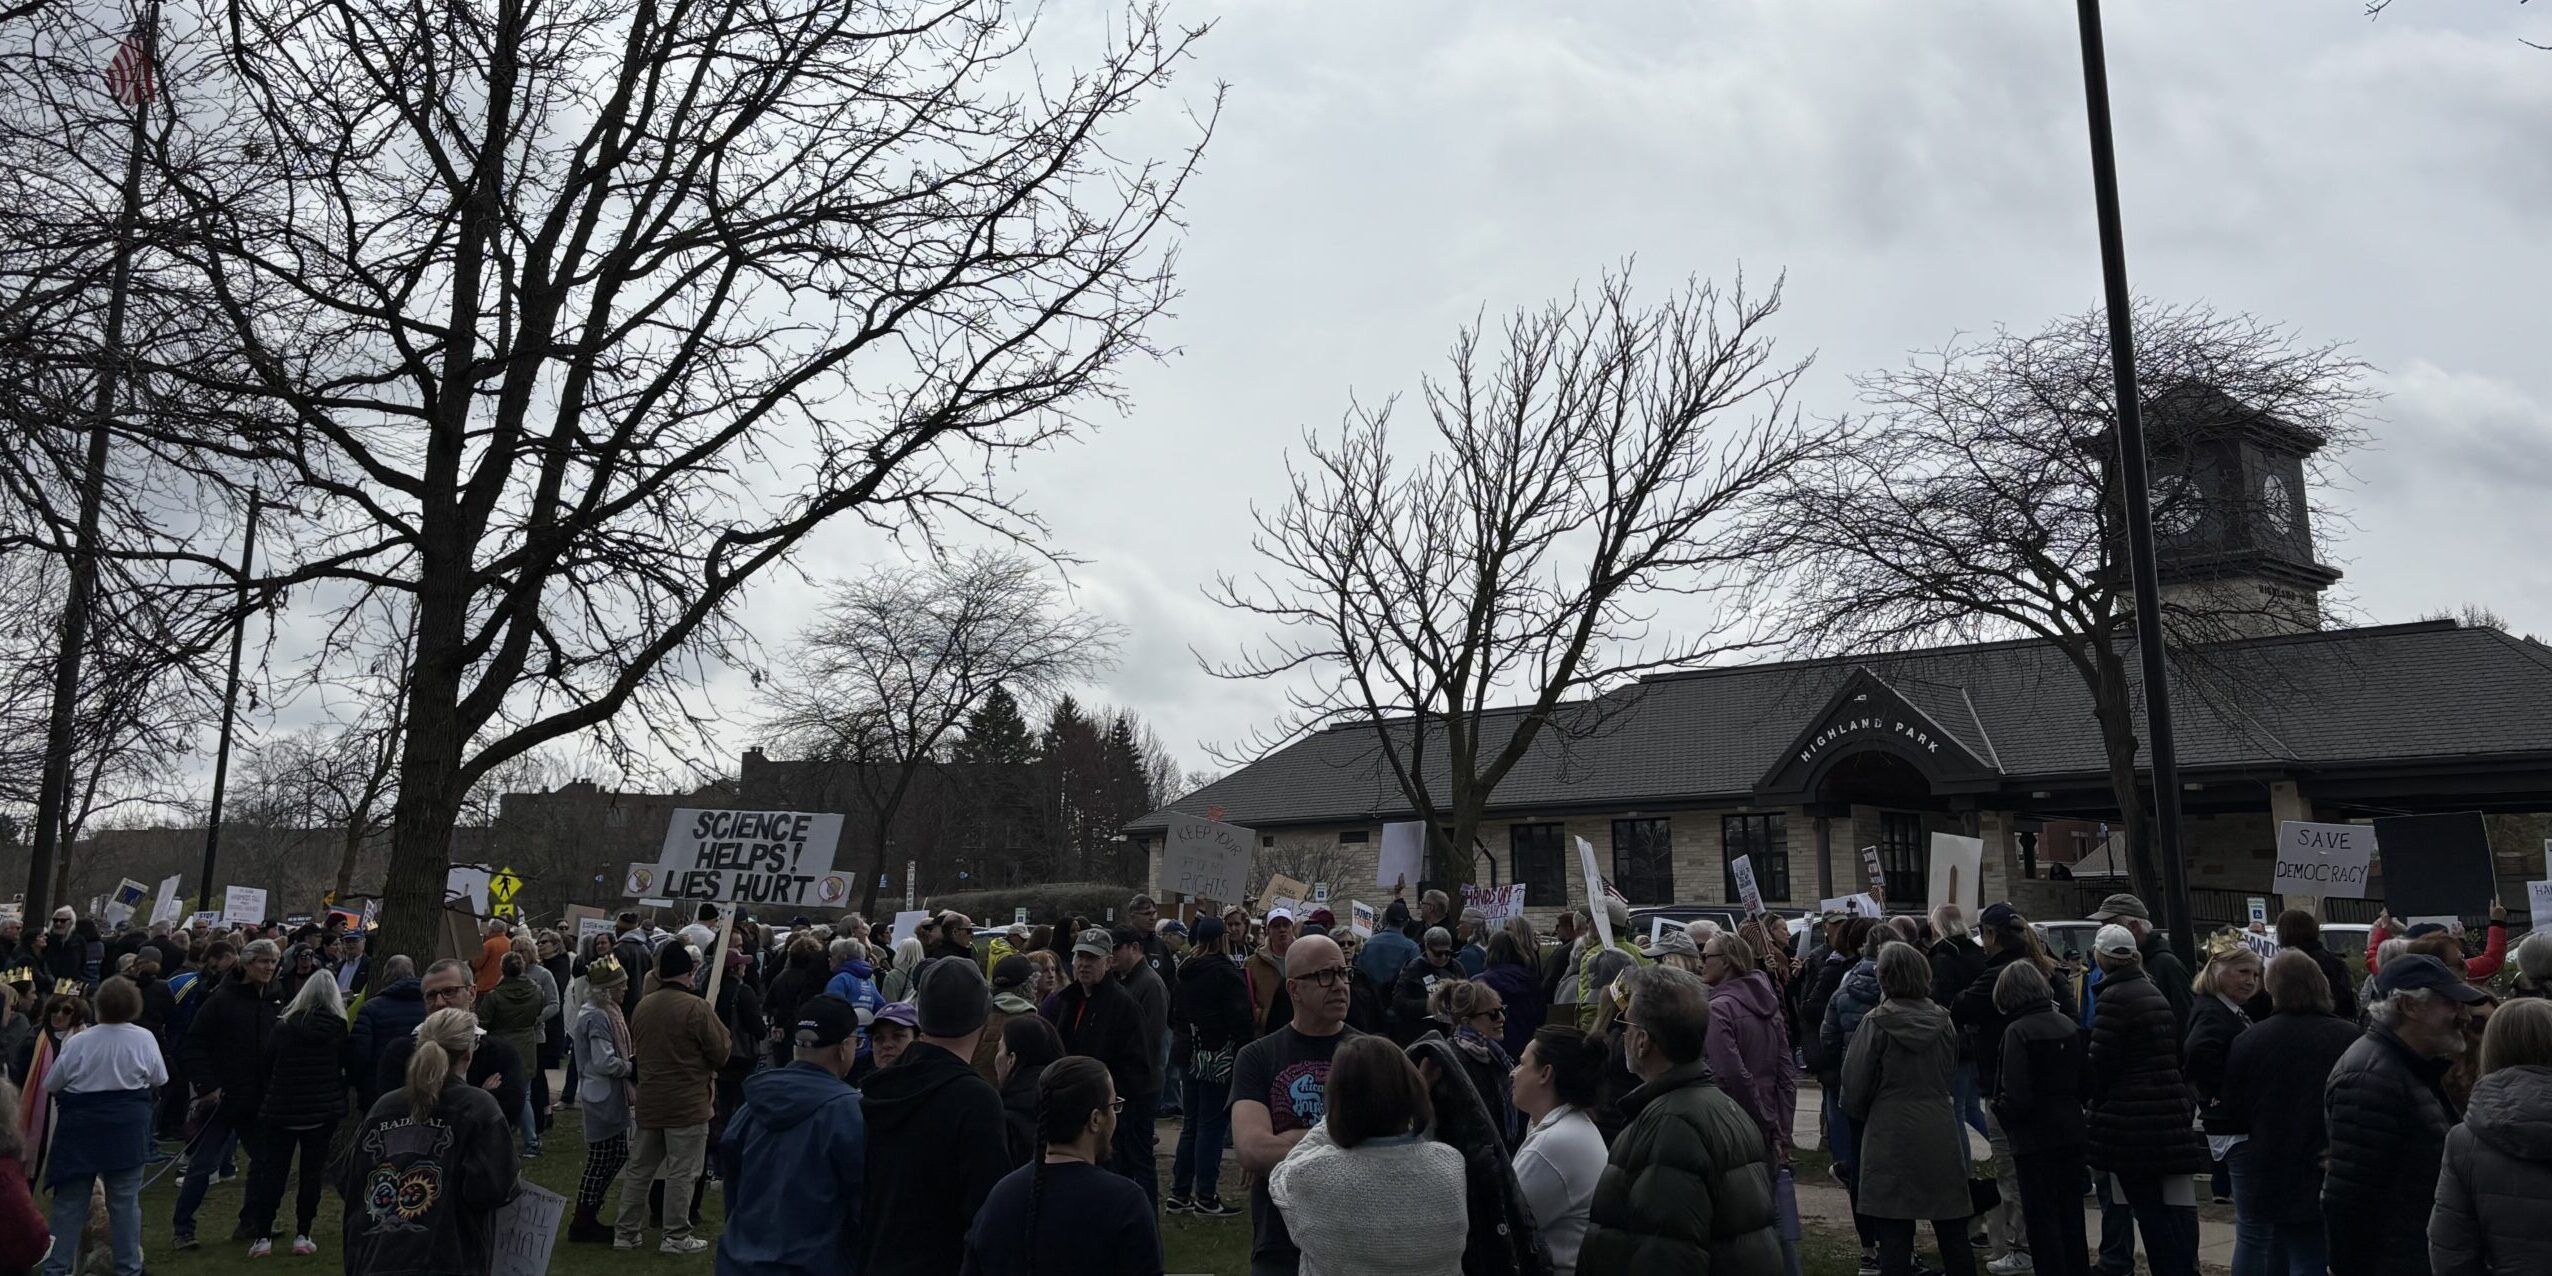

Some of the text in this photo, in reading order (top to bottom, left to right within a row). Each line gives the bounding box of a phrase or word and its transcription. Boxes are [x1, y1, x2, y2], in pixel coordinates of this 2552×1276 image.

[1801, 718, 1938, 762] HIGHLAND PARK
[692, 811, 813, 843] SCIENCE
[2297, 829, 2352, 849] SAVE
[1176, 825, 1242, 856] KEEP YOUR
[695, 842, 803, 875] HELPS!
[1179, 872, 1229, 898] RIGHTS
[2277, 861, 2367, 884] DEMOCRACY
[662, 870, 815, 904] LIES HURT
[1466, 887, 1496, 906] HANDS
[2535, 884, 2552, 897] HA
[379, 1117, 447, 1132] RADAL
